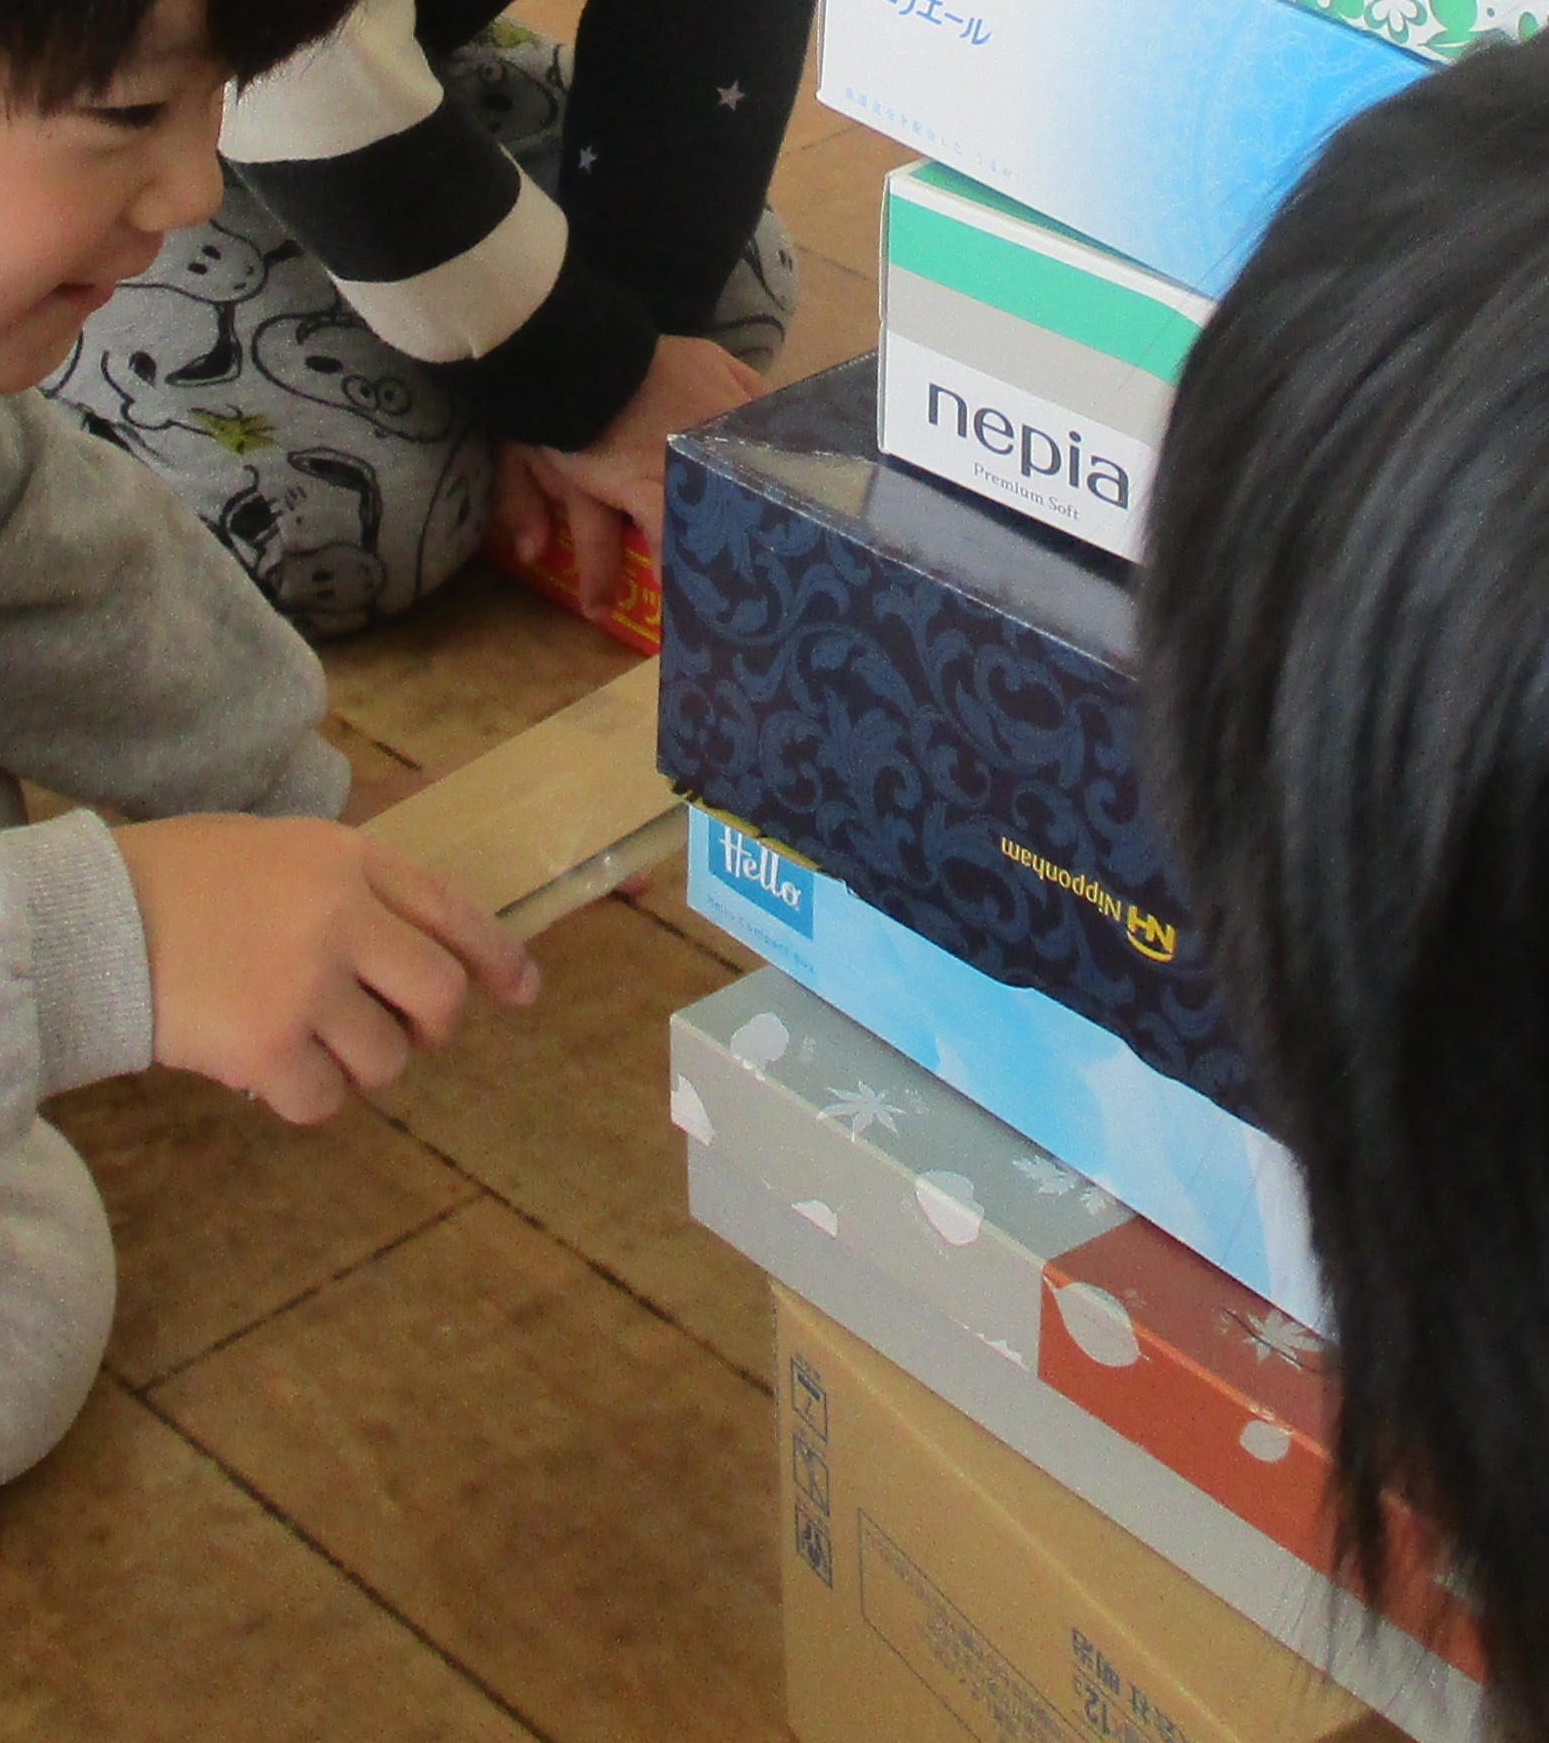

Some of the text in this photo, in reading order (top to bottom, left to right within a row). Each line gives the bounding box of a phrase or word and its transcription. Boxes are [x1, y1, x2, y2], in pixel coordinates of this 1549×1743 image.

[927, 380, 1130, 509] nepia
[972, 460, 1081, 522] Premium Soft
[719, 824, 802, 910] Hello
[1000, 835, 1122, 922] Nipponham
